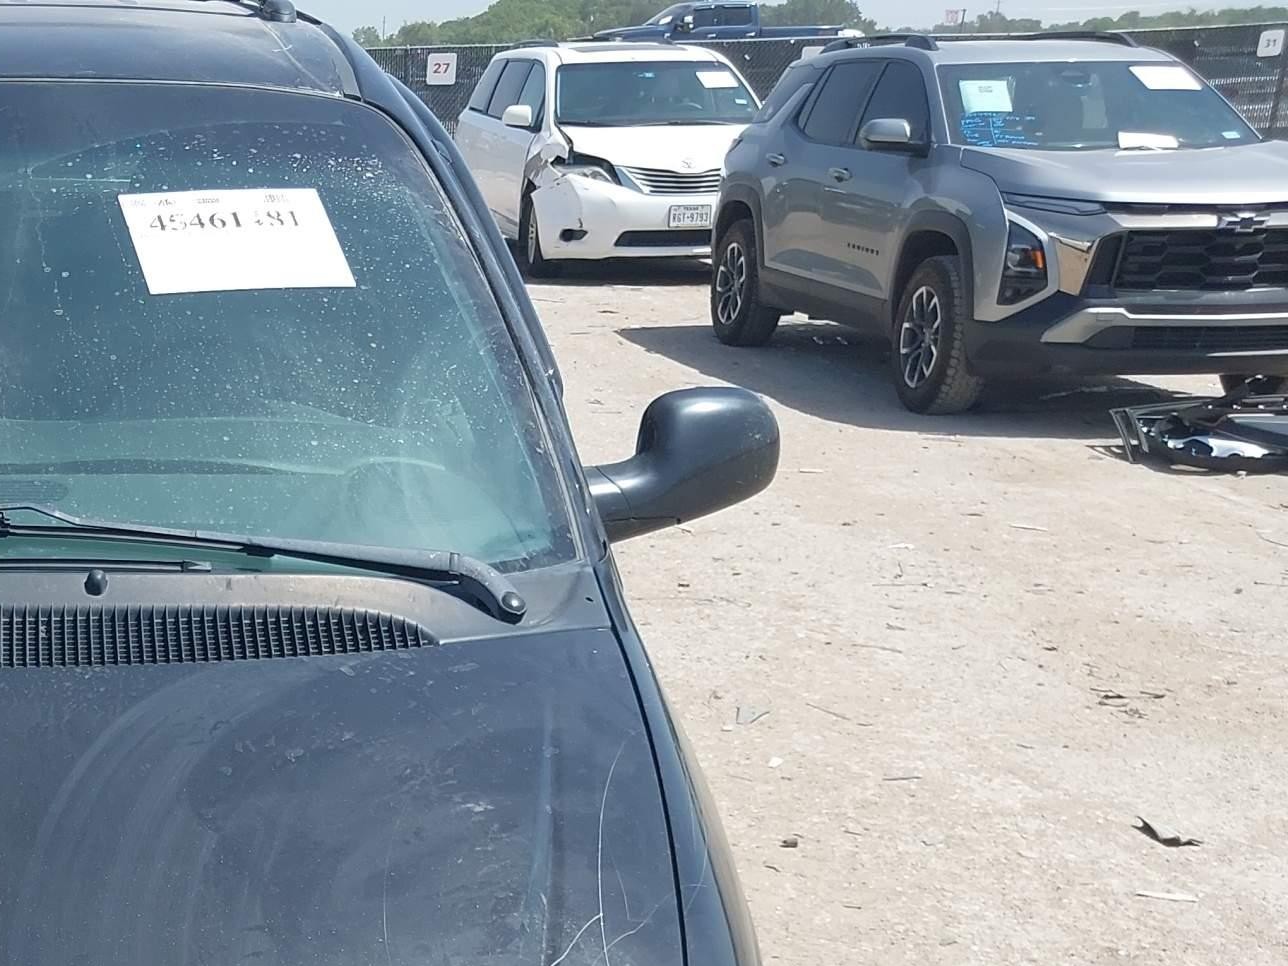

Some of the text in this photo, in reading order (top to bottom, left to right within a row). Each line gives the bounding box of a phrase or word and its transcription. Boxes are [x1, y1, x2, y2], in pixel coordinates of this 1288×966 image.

[1264, 39, 1278, 49] 31
[432, 62, 451, 74] 27
[149, 210, 300, 231] 4546181
